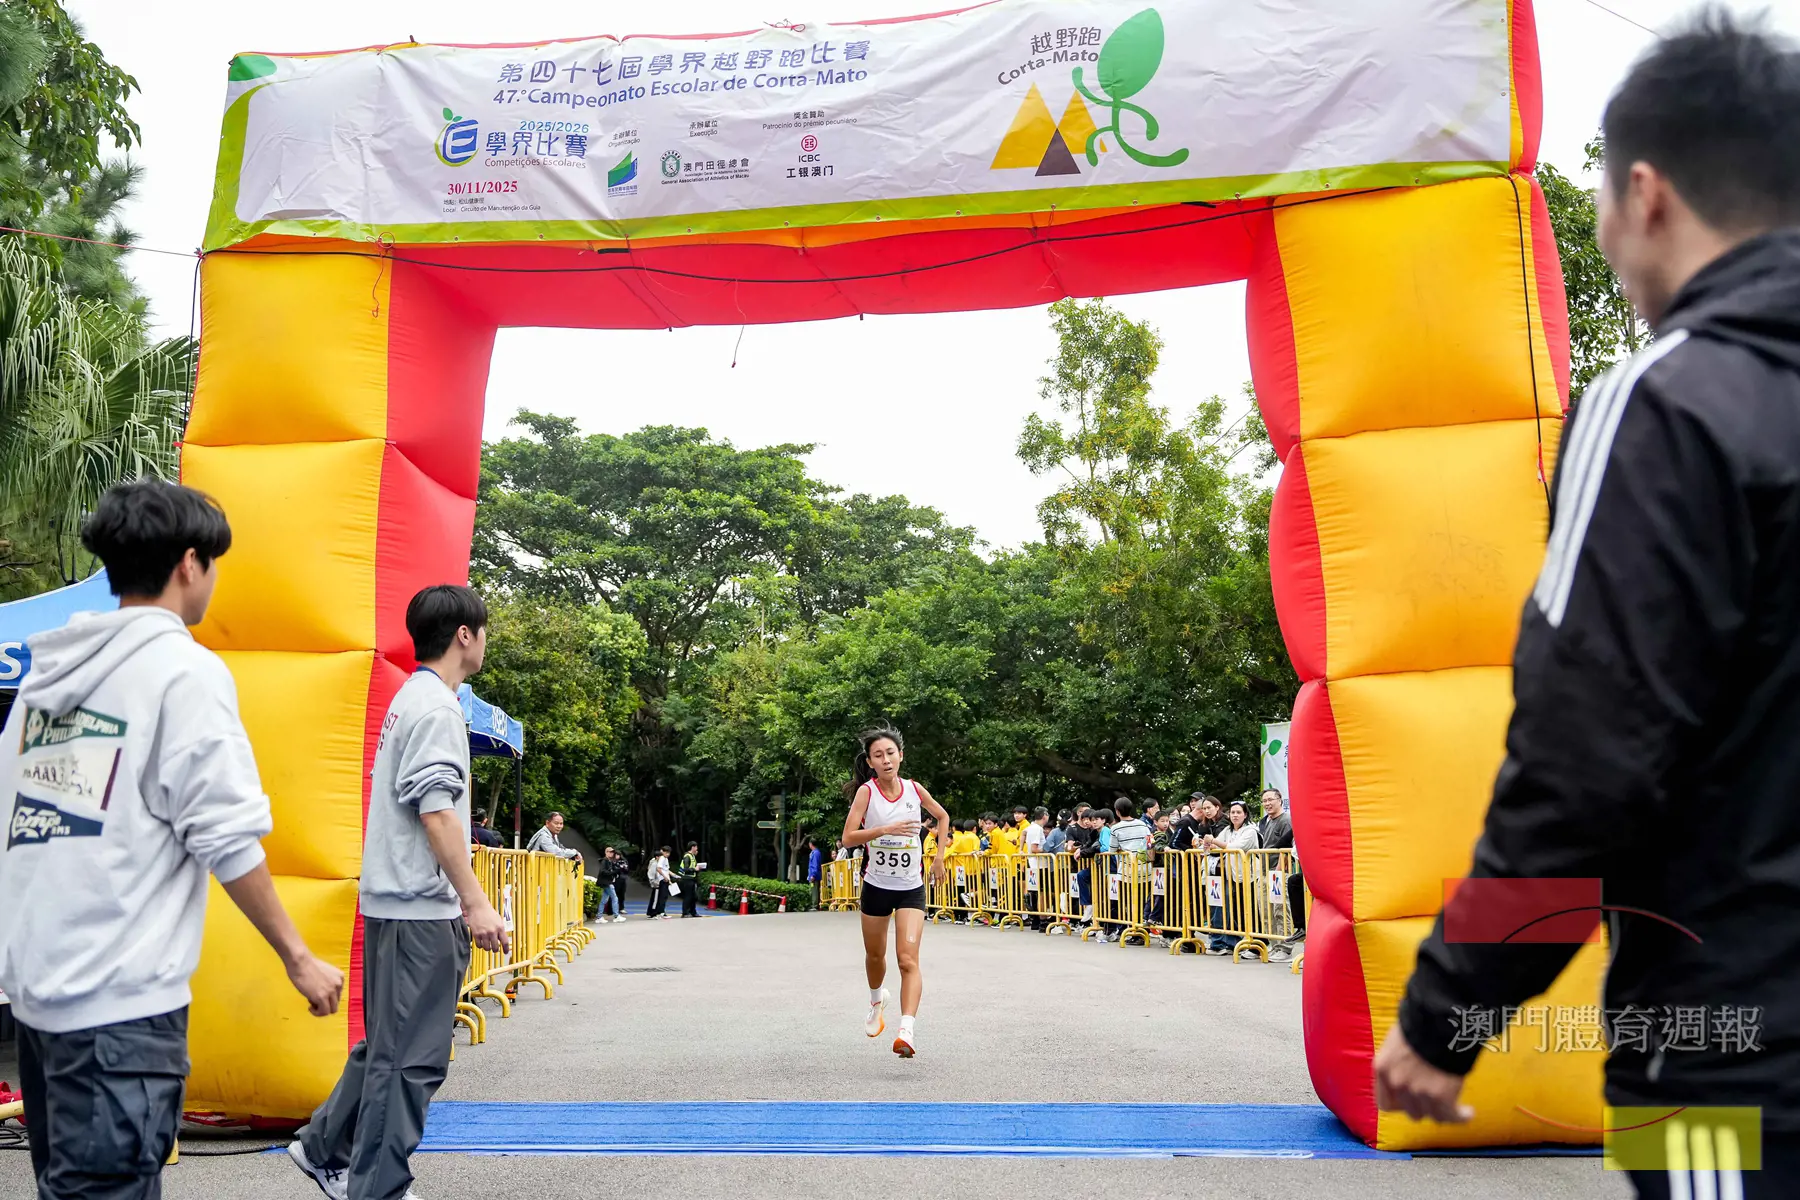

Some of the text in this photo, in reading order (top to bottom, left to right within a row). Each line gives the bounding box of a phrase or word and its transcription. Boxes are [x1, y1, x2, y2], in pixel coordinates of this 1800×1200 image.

[1030, 26, 1101, 55] 越野跑
[497, 41, 870, 87] 第四十七屆學界越野跑比賽
[997, 50, 1099, 86] Corta-Mato
[528, 85, 646, 109] Campeonato
[651, 78, 719, 97] Escolar
[723, 75, 747, 91] de
[753, 68, 868, 88] Corta-Mato
[519, 121, 590, 134] 2025/2026
[689, 129, 718, 138] Execução
[485, 131, 588, 159] 學界比賽
[484, 157, 586, 169] Competições Escolares
[683, 158, 749, 172] 澳門田徑總會
[798, 154, 821, 163] ICBC
[786, 165, 834, 179] 工银澳门
[447, 181, 518, 195] 30/11/2025
[875, 850, 911, 868] 359
